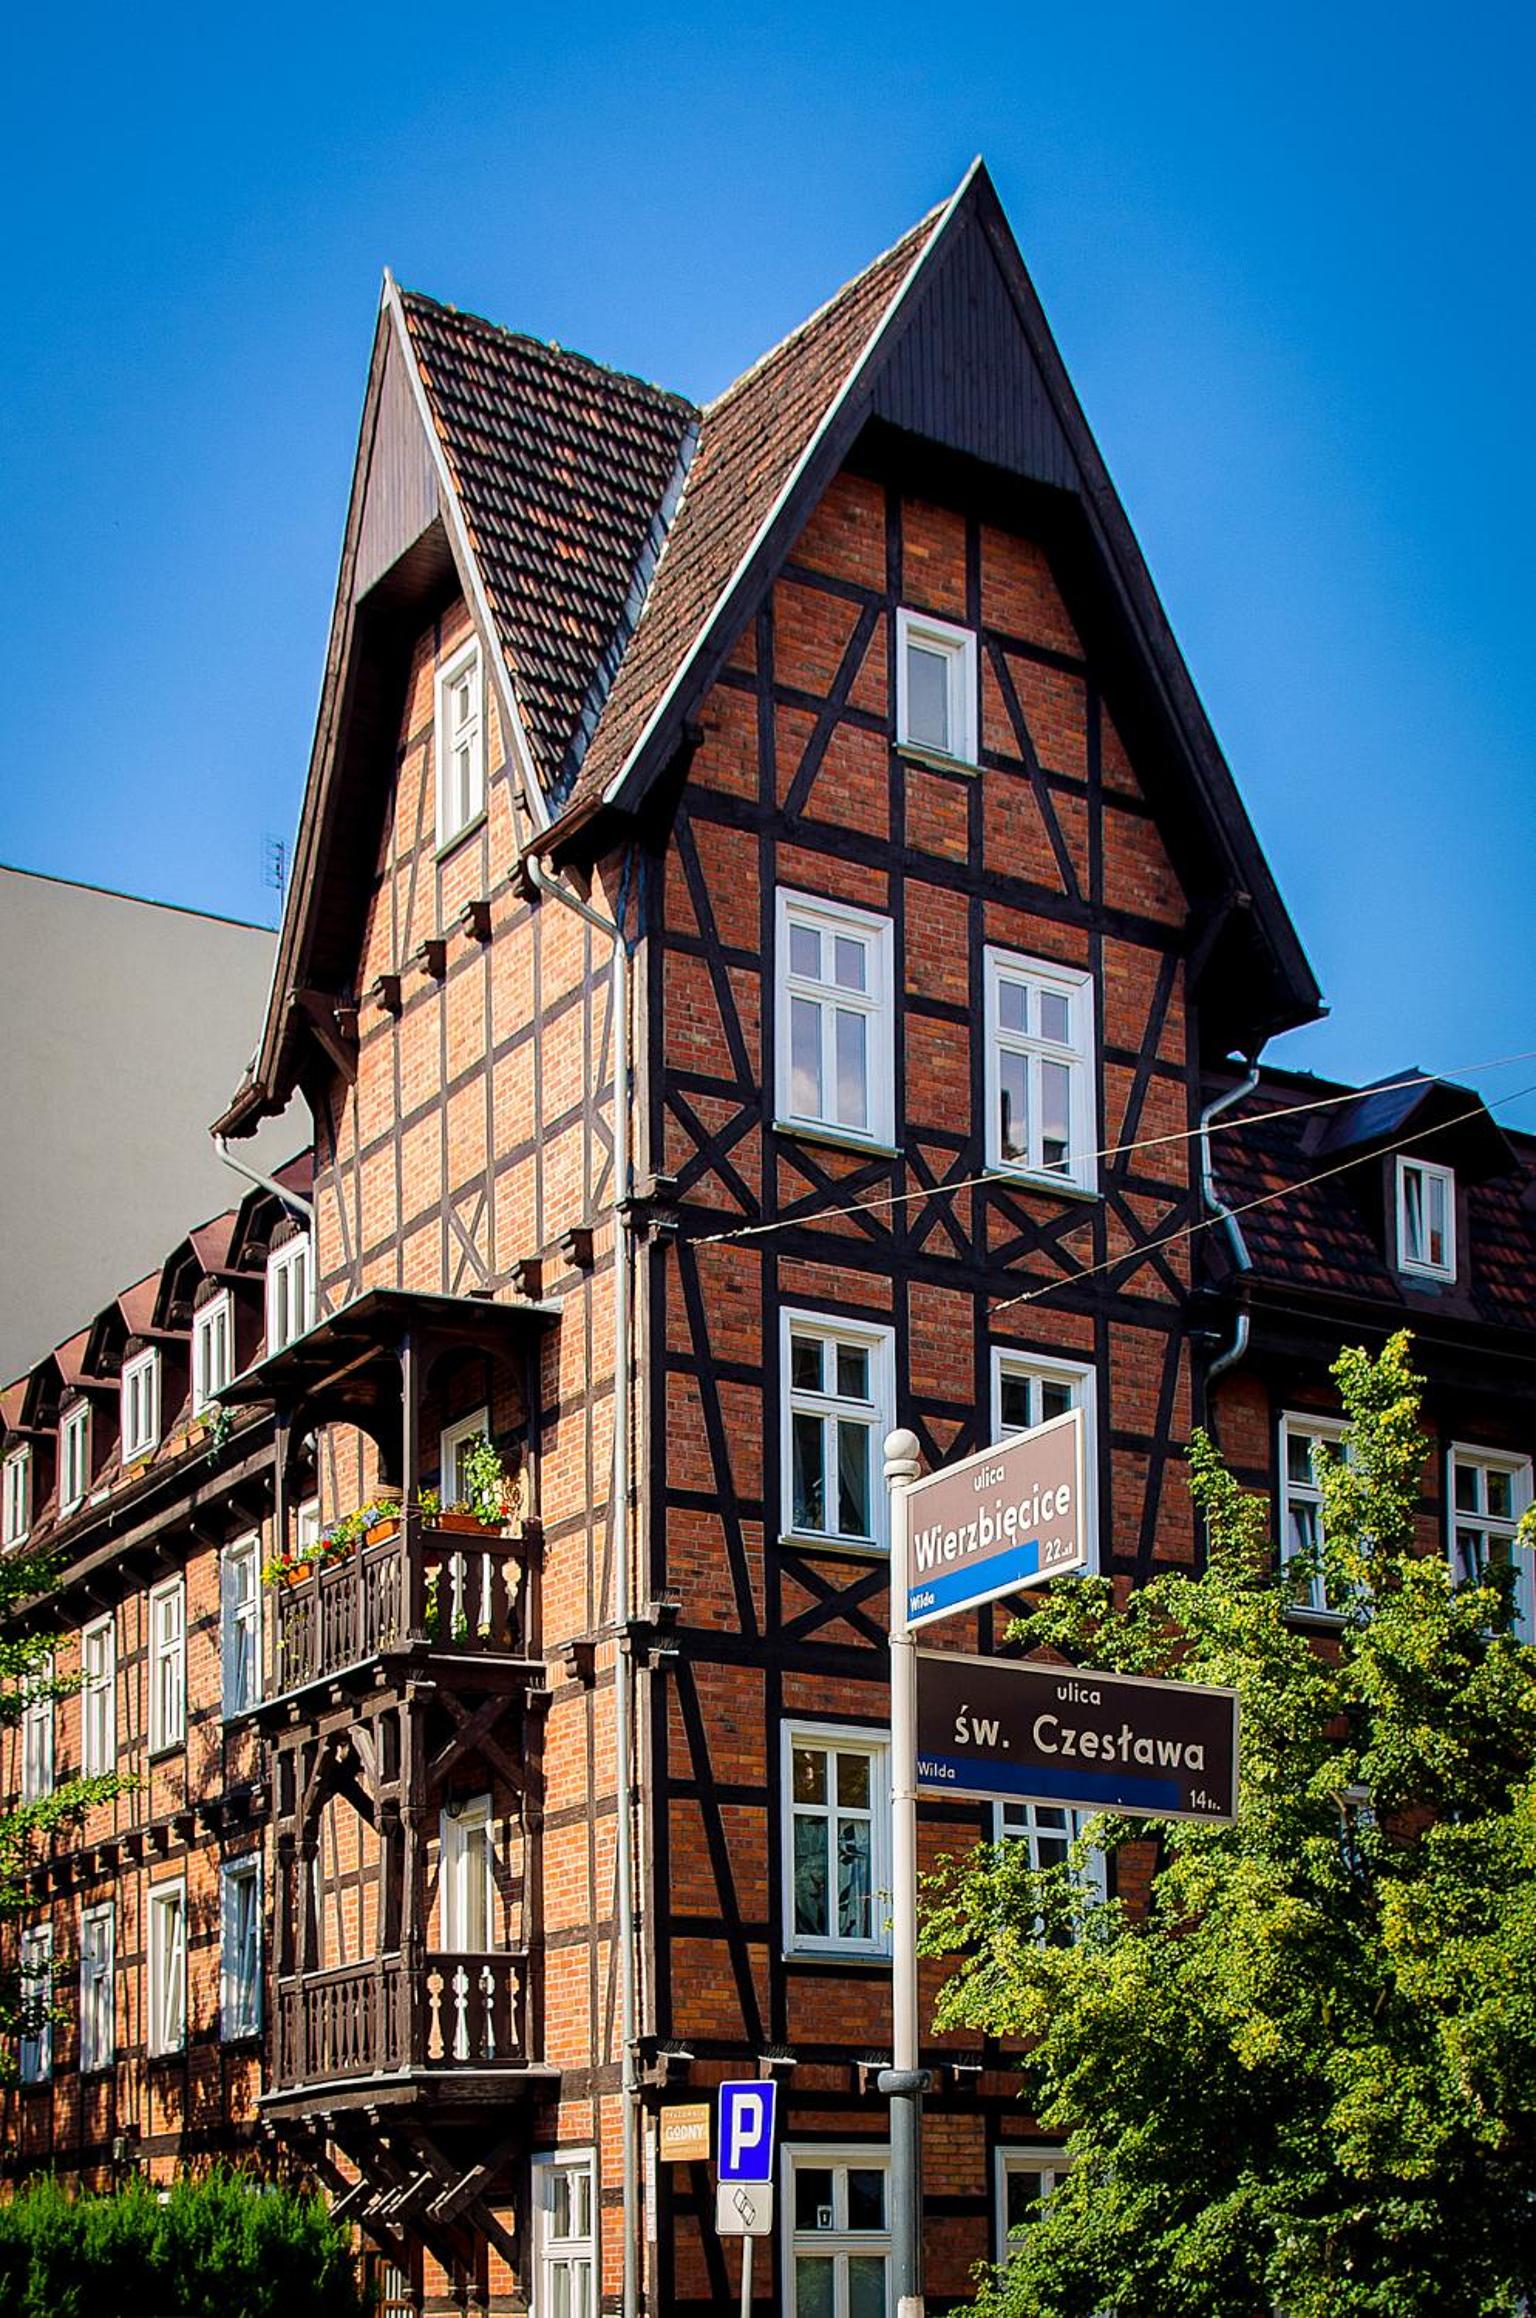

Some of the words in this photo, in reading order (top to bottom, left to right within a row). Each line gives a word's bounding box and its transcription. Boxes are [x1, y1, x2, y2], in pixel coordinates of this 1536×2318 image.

[974, 1465, 1005, 1492] ulica
[914, 1483, 1071, 1572] Wierzbięcice
[910, 1591, 934, 1612] Wilda
[1057, 1682, 1101, 1705] ulica
[954, 1704, 1010, 1749] św.
[1032, 1714, 1205, 1771] Czesława
[917, 1761, 956, 1779] Wilda
[730, 2094, 763, 2169] P
